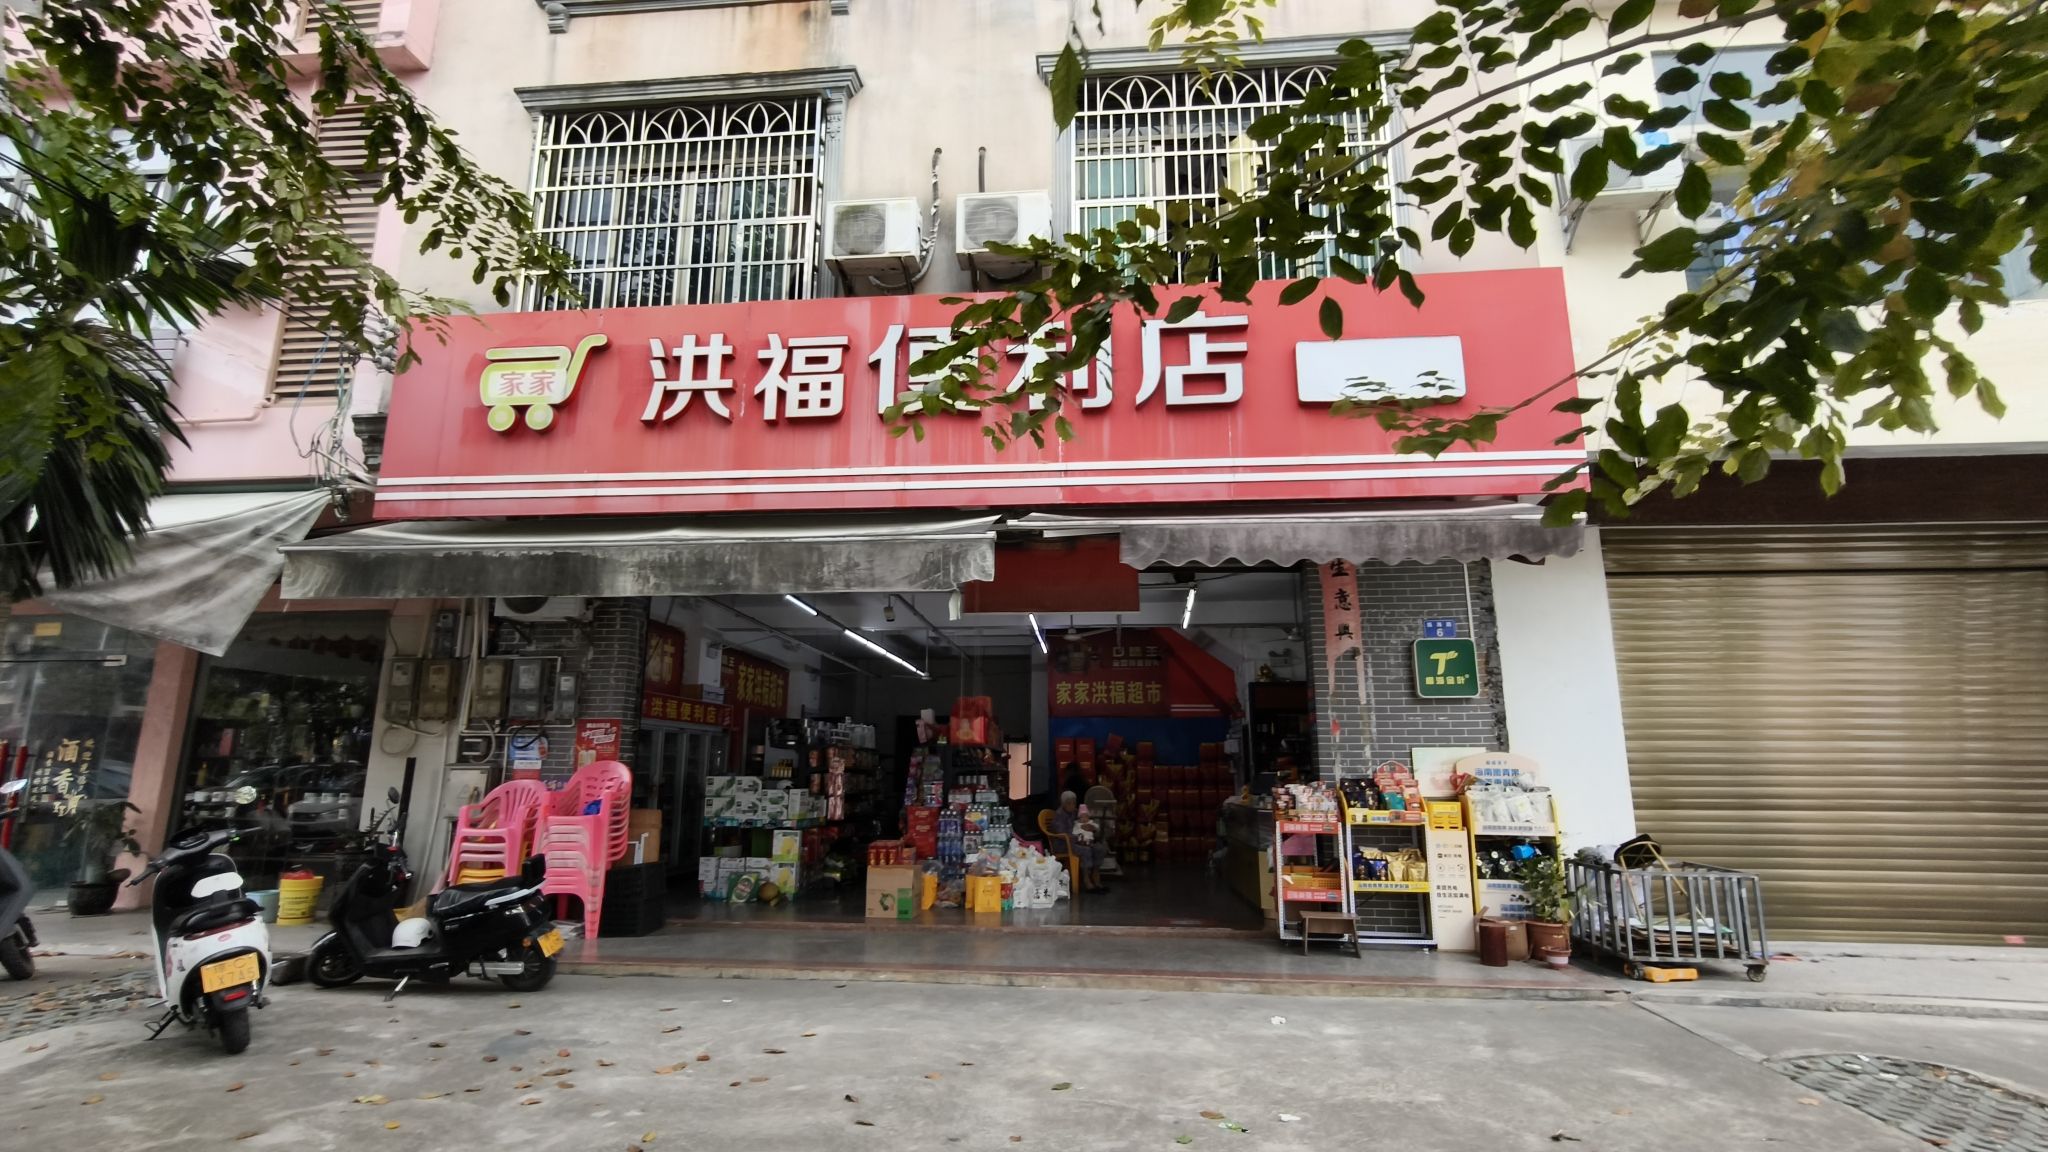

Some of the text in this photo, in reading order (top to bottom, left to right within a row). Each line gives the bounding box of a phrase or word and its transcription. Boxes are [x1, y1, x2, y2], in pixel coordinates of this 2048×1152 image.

[640, 311, 1249, 422] 洪福便利店
[498, 370, 556, 397] 家家
[1436, 628, 1444, 637] 6
[1056, 680, 1163, 705] 家家洪福超市
[651, 697, 718, 725] 洪福便利店
